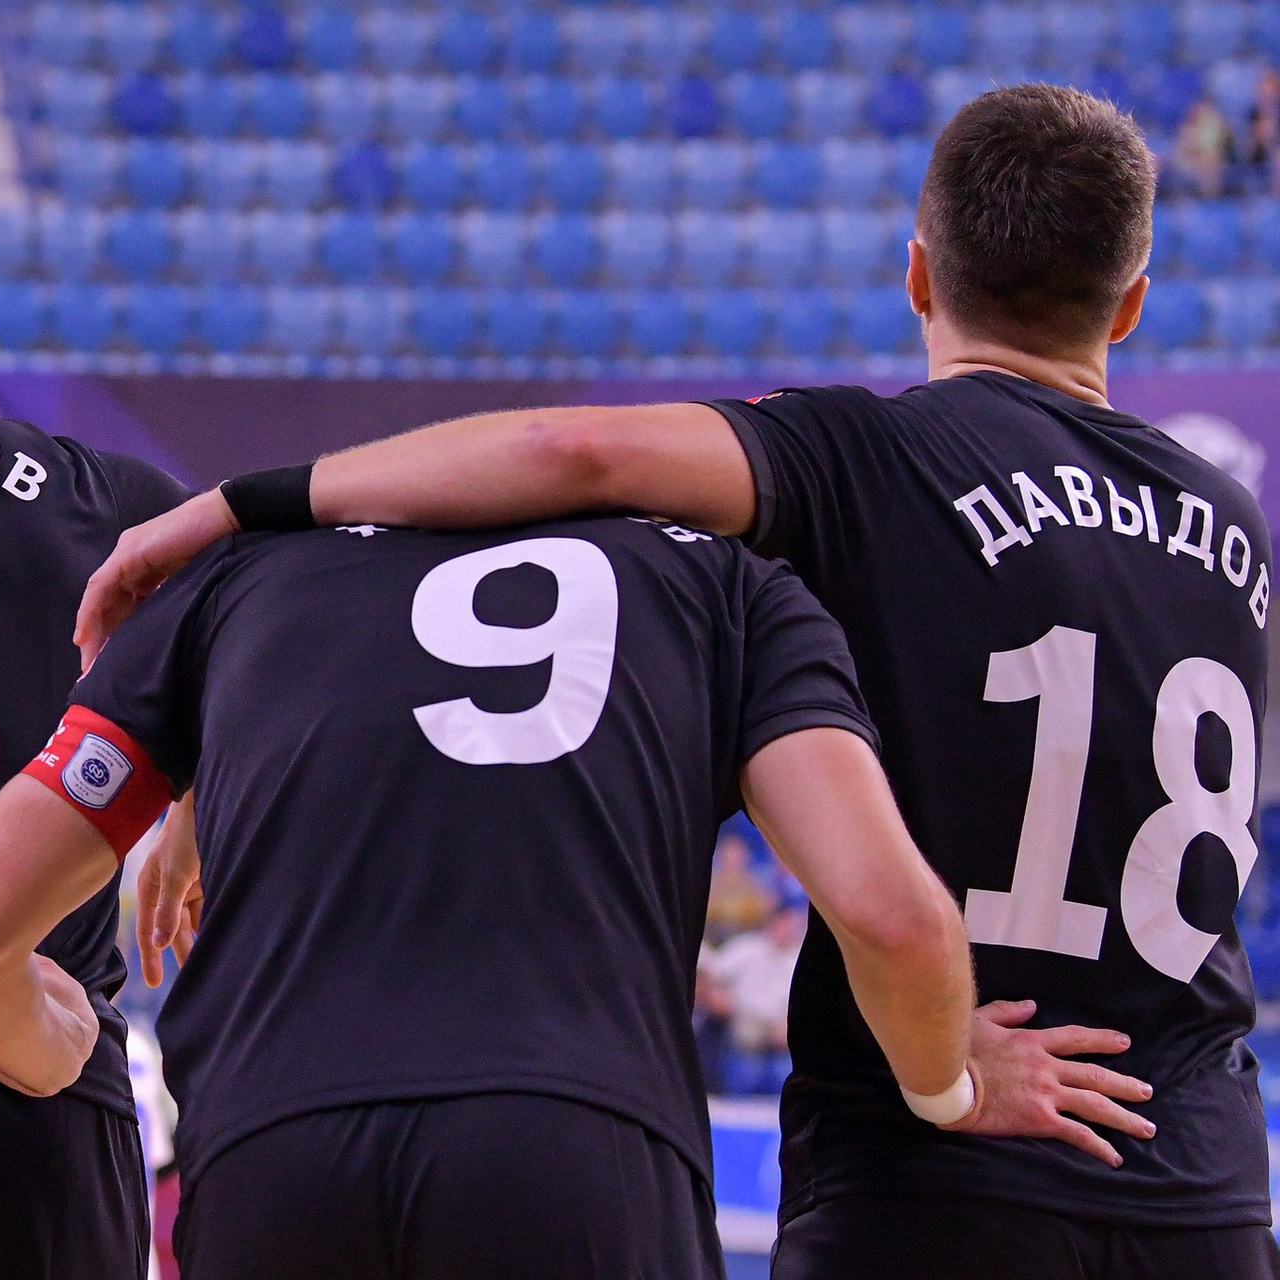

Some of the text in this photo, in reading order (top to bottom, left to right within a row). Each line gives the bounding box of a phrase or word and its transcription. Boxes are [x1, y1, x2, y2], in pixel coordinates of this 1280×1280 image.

[411, 537, 619, 765] 9
[953, 464, 1271, 629] ДАВЫДОВ
[963, 624, 1259, 984] 18
